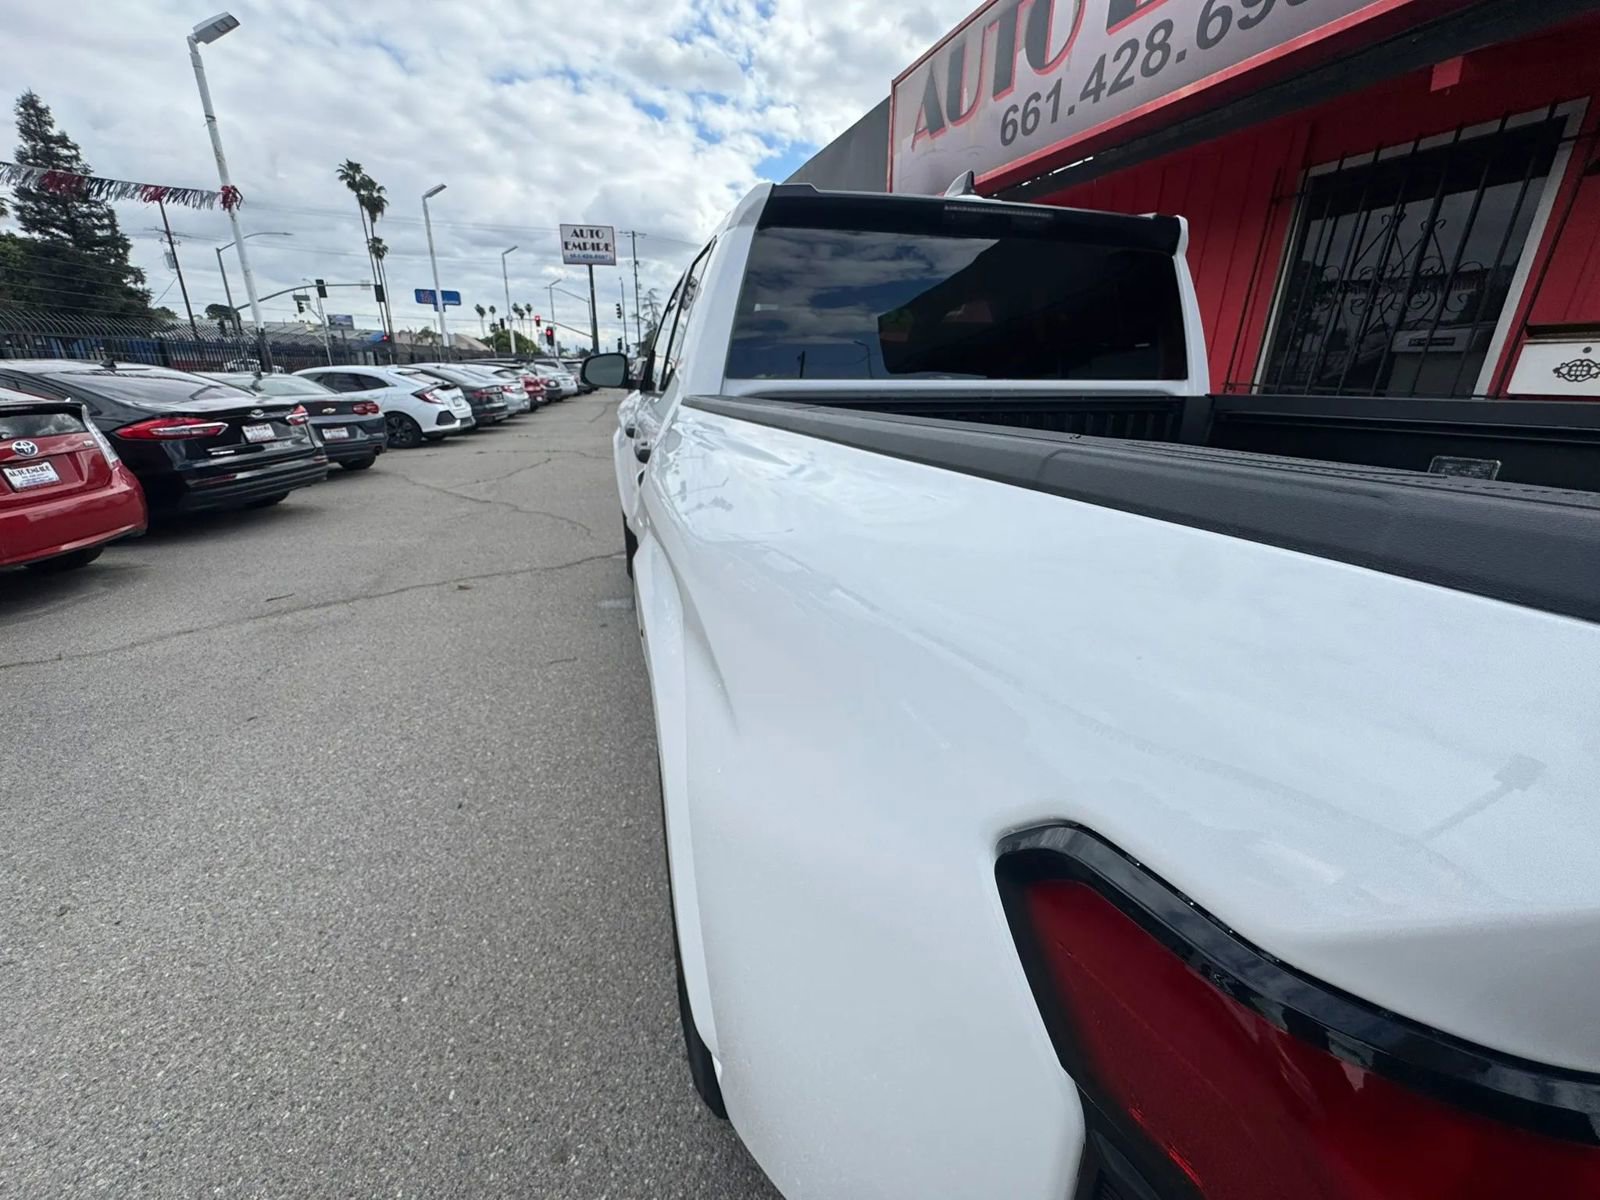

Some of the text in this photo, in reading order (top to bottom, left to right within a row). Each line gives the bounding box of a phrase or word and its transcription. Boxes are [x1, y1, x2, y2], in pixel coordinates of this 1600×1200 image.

[911, 0, 1087, 152] AUTO
[570, 228, 604, 240] AUTO
[563, 240, 612, 252] EMPIRE
